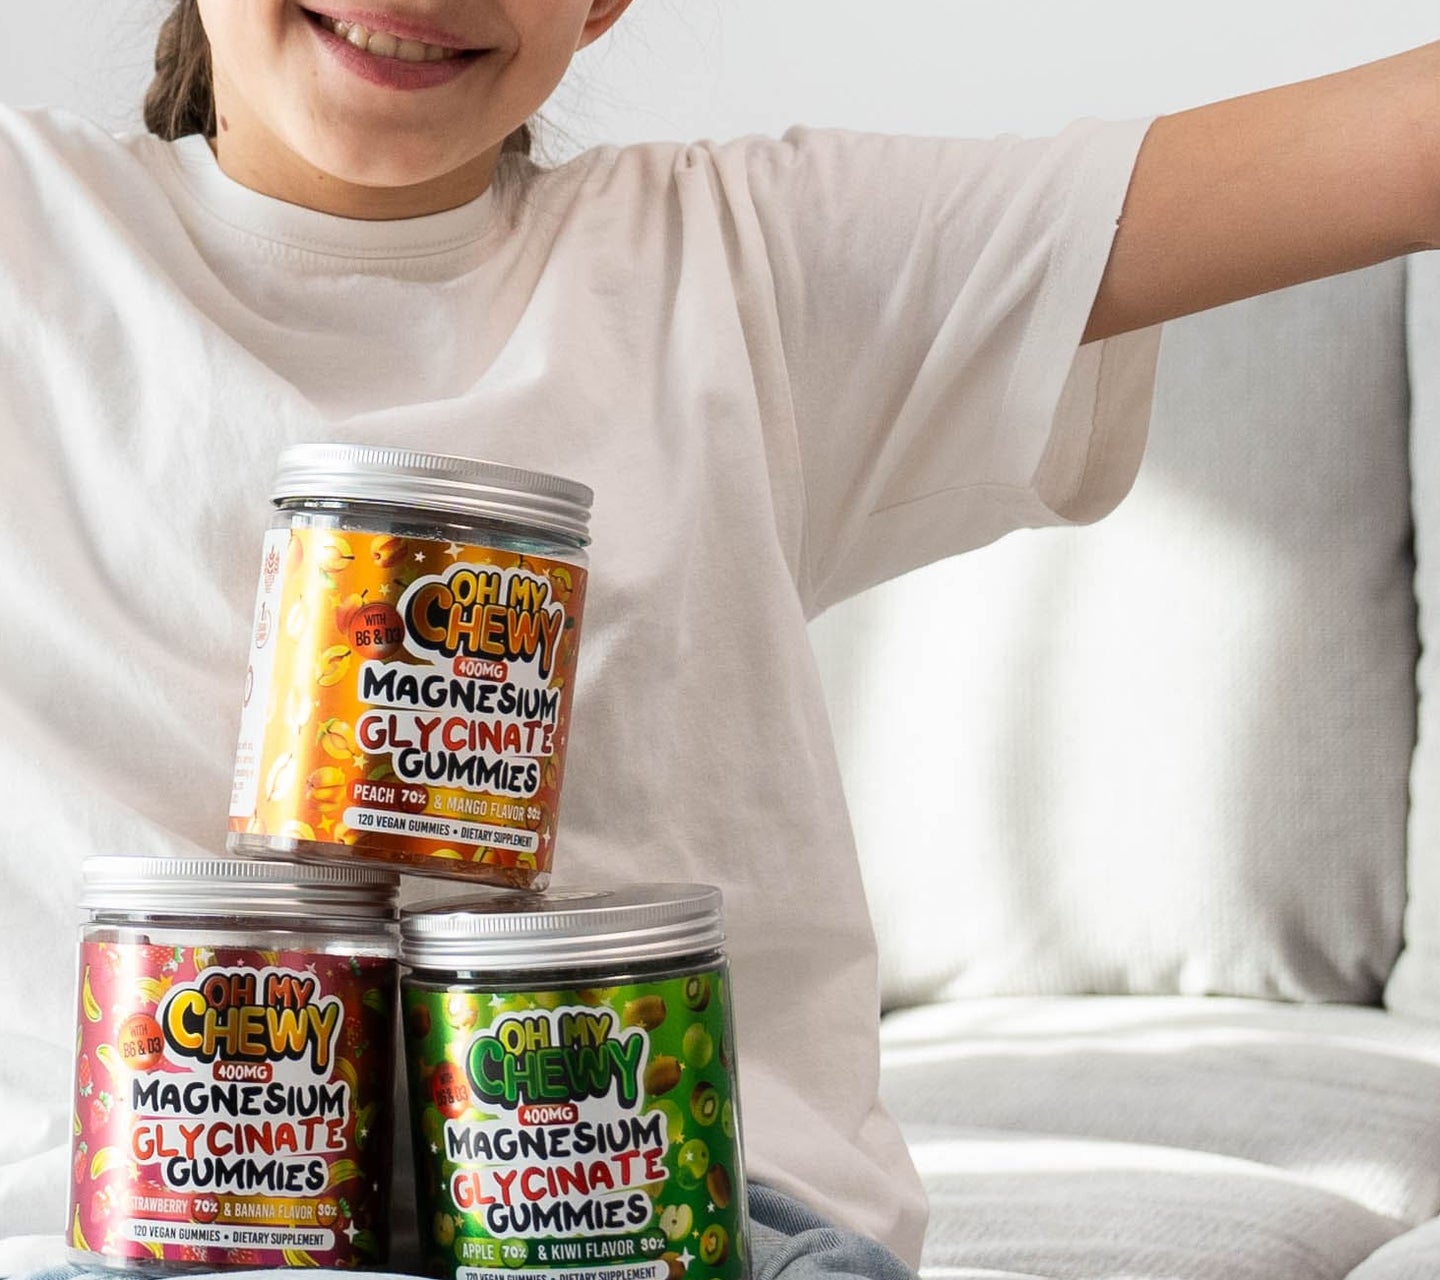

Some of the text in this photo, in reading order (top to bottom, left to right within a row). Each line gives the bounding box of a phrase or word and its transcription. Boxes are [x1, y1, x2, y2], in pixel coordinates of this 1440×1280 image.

[451, 570, 547, 612] OH MY
[355, 629, 371, 646] B6
[373, 629, 384, 645] &
[365, 613, 387, 627] WITH
[411, 582, 562, 672] CHEWY
[458, 661, 504, 678] 400MG
[363, 666, 559, 723] MAGNESIUM
[359, 714, 555, 755] GLYCINATE
[397, 748, 538, 793] GUMMIES
[353, 783, 395, 804] PEACH
[401, 789, 427, 805] 70%
[433, 795, 442, 810] &
[446, 797, 487, 817] MANGO
[490, 802, 525, 821] FLAVOR
[357, 813, 534, 848] 120 VEGAN GUMMIES DIETARY SUPPLEMENT
[203, 974, 315, 1010] OH MY
[123, 1036, 162, 1058] B6 & D3
[130, 1023, 149, 1037] WITH
[167, 989, 339, 1068] CHEWY
[499, 1014, 611, 1055] OH MY
[218, 1064, 268, 1080] 400MG
[470, 1034, 644, 1102] CHEWY
[132, 1078, 346, 1118] MAGNESIUM
[523, 1107, 573, 1124] 400MG
[132, 1116, 346, 1160] GLYCINATE
[447, 1113, 663, 1161] MAGNESIUM
[166, 1156, 325, 1192] GUMMIES
[453, 1147, 666, 1208] GLYCINATE
[193, 1198, 218, 1213] 70%
[223, 1203, 232, 1217] &
[234, 1202, 275, 1218] BANANA
[278, 1204, 313, 1219] FLAVOR
[486, 1193, 648, 1233] GUMMIES
[133, 1225, 325, 1246] 120 VEGAN GUMMIES DIETARY SUPPLEMENT
[462, 1243, 495, 1260] APPLE
[502, 1245, 528, 1259] 70%
[537, 1246, 548, 1261] &
[551, 1243, 582, 1260] KIWI
[586, 1239, 635, 1259] FLAVOR
